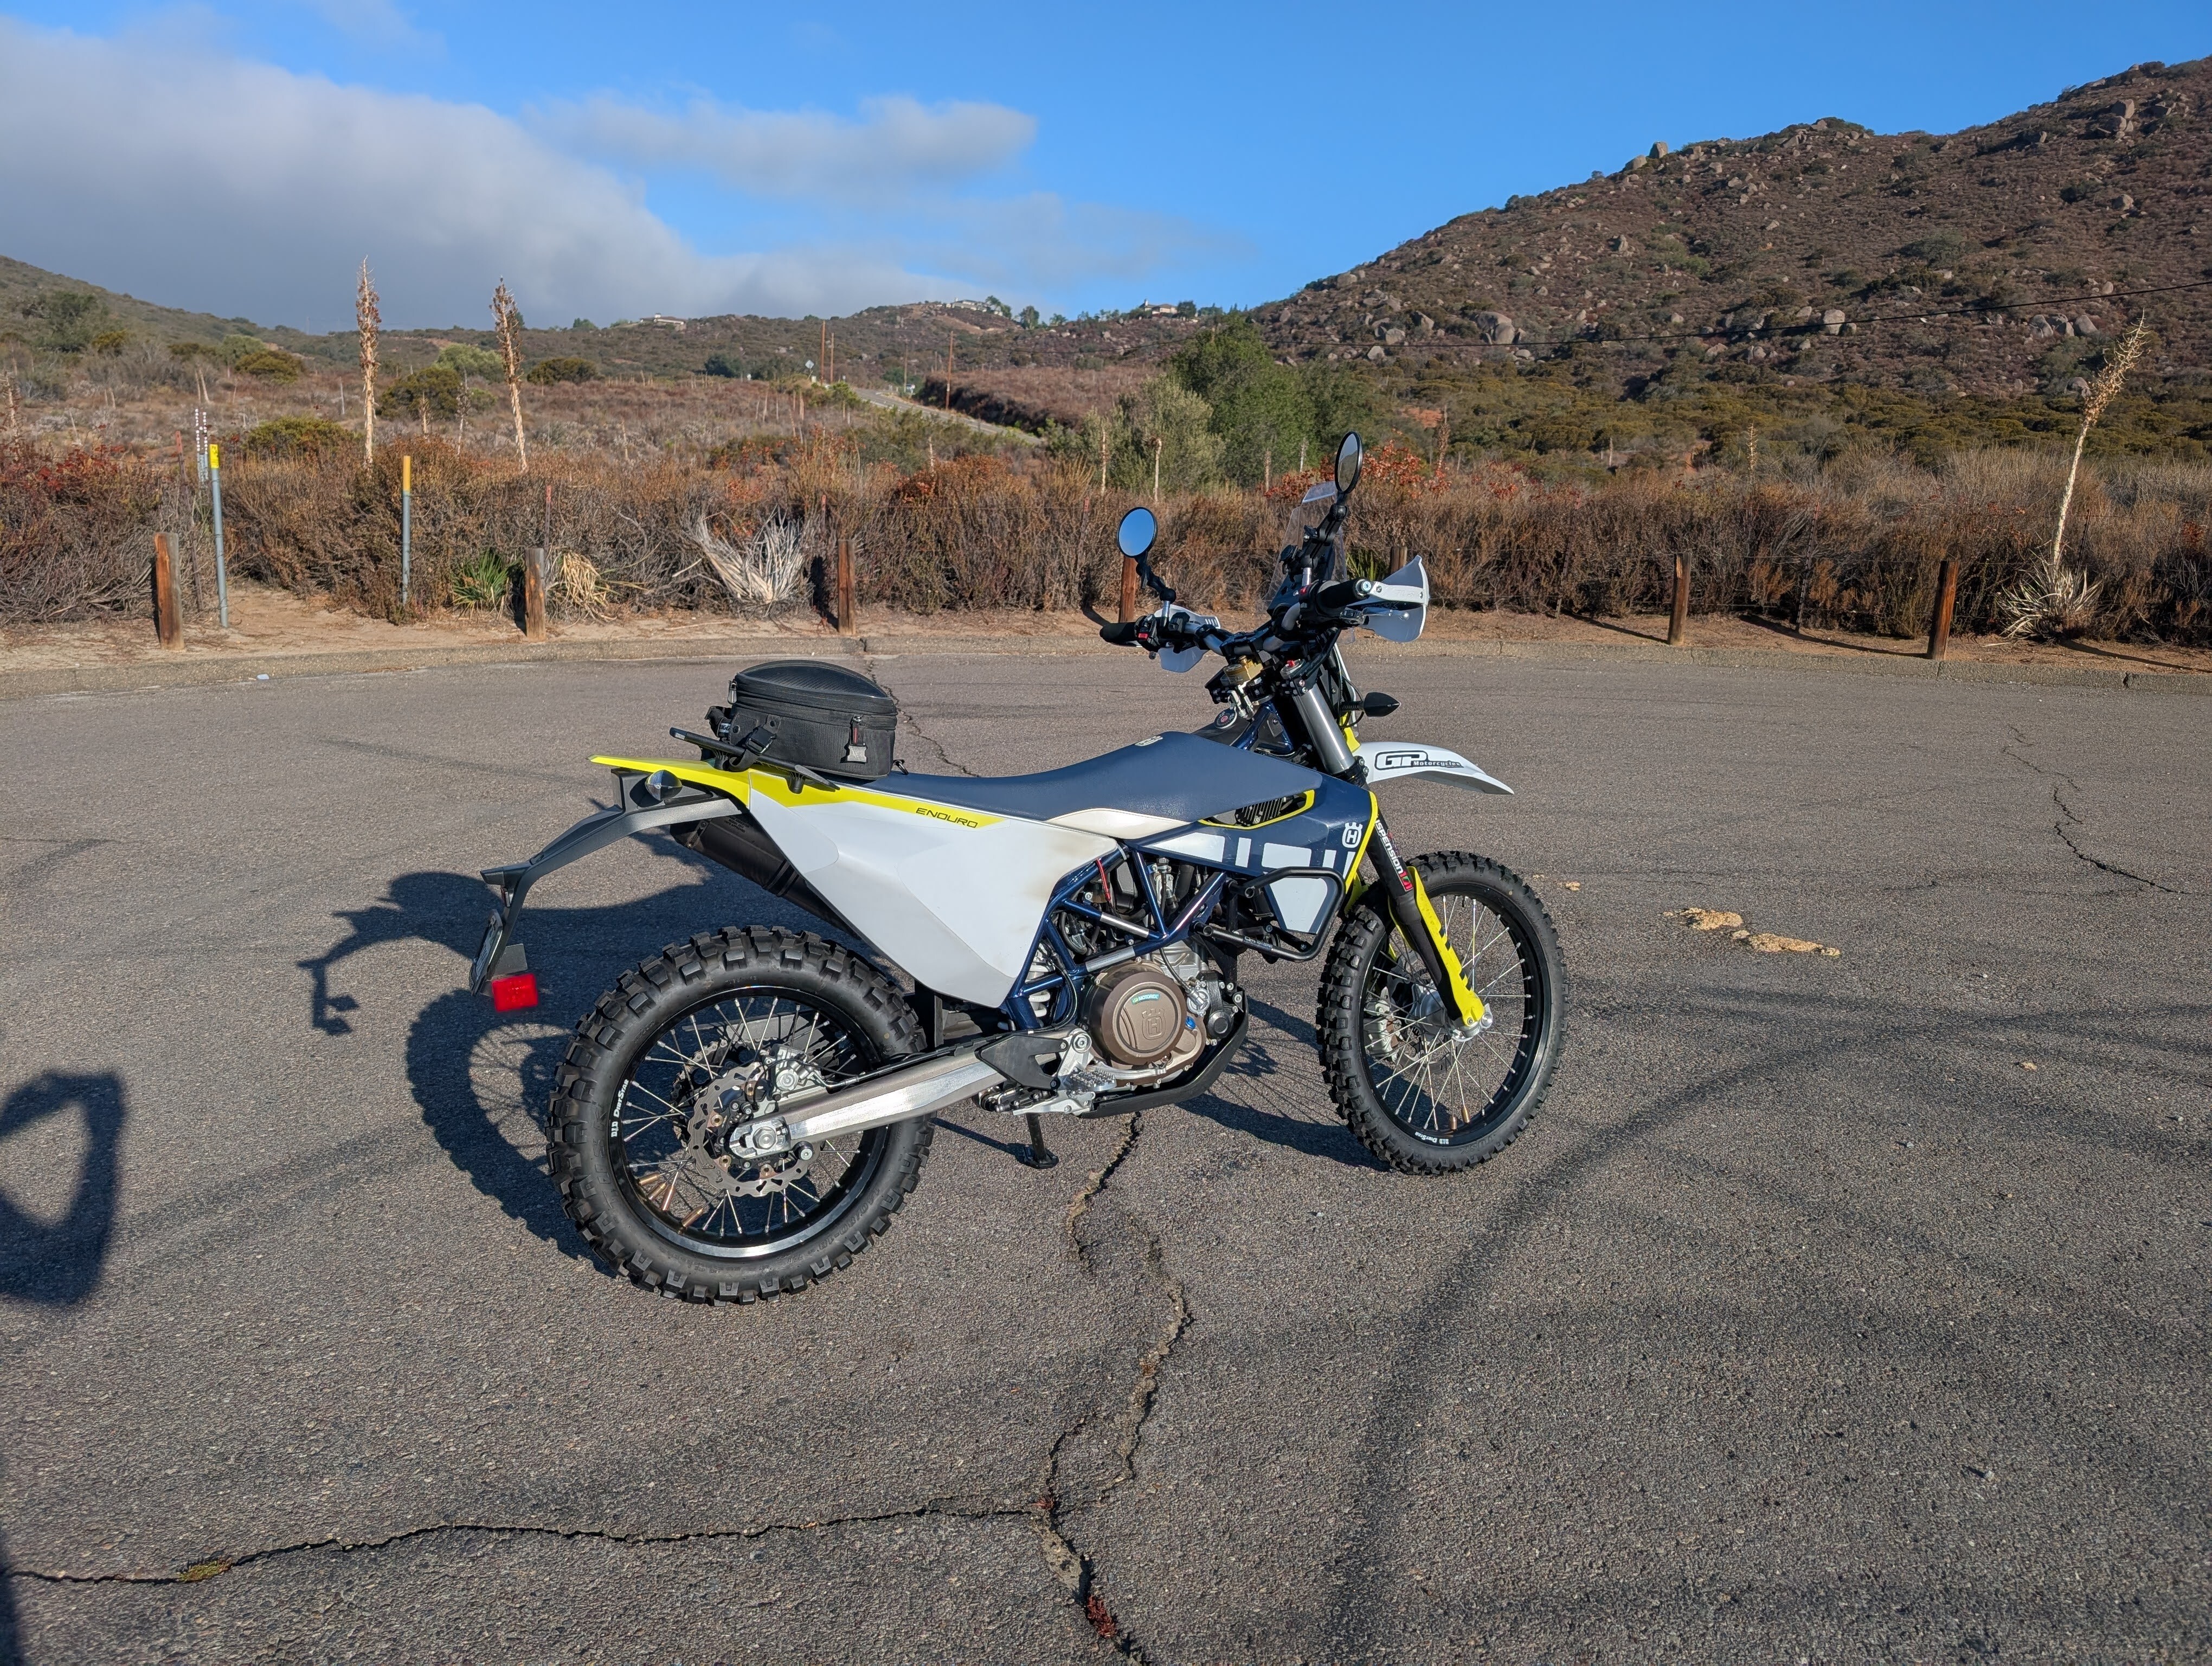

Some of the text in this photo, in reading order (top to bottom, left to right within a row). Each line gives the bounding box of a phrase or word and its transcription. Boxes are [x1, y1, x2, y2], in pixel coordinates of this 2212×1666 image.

[1375, 752, 1427, 769] GP
[915, 807, 979, 828] ENDURO
[1375, 819, 1404, 874] SPENSION
